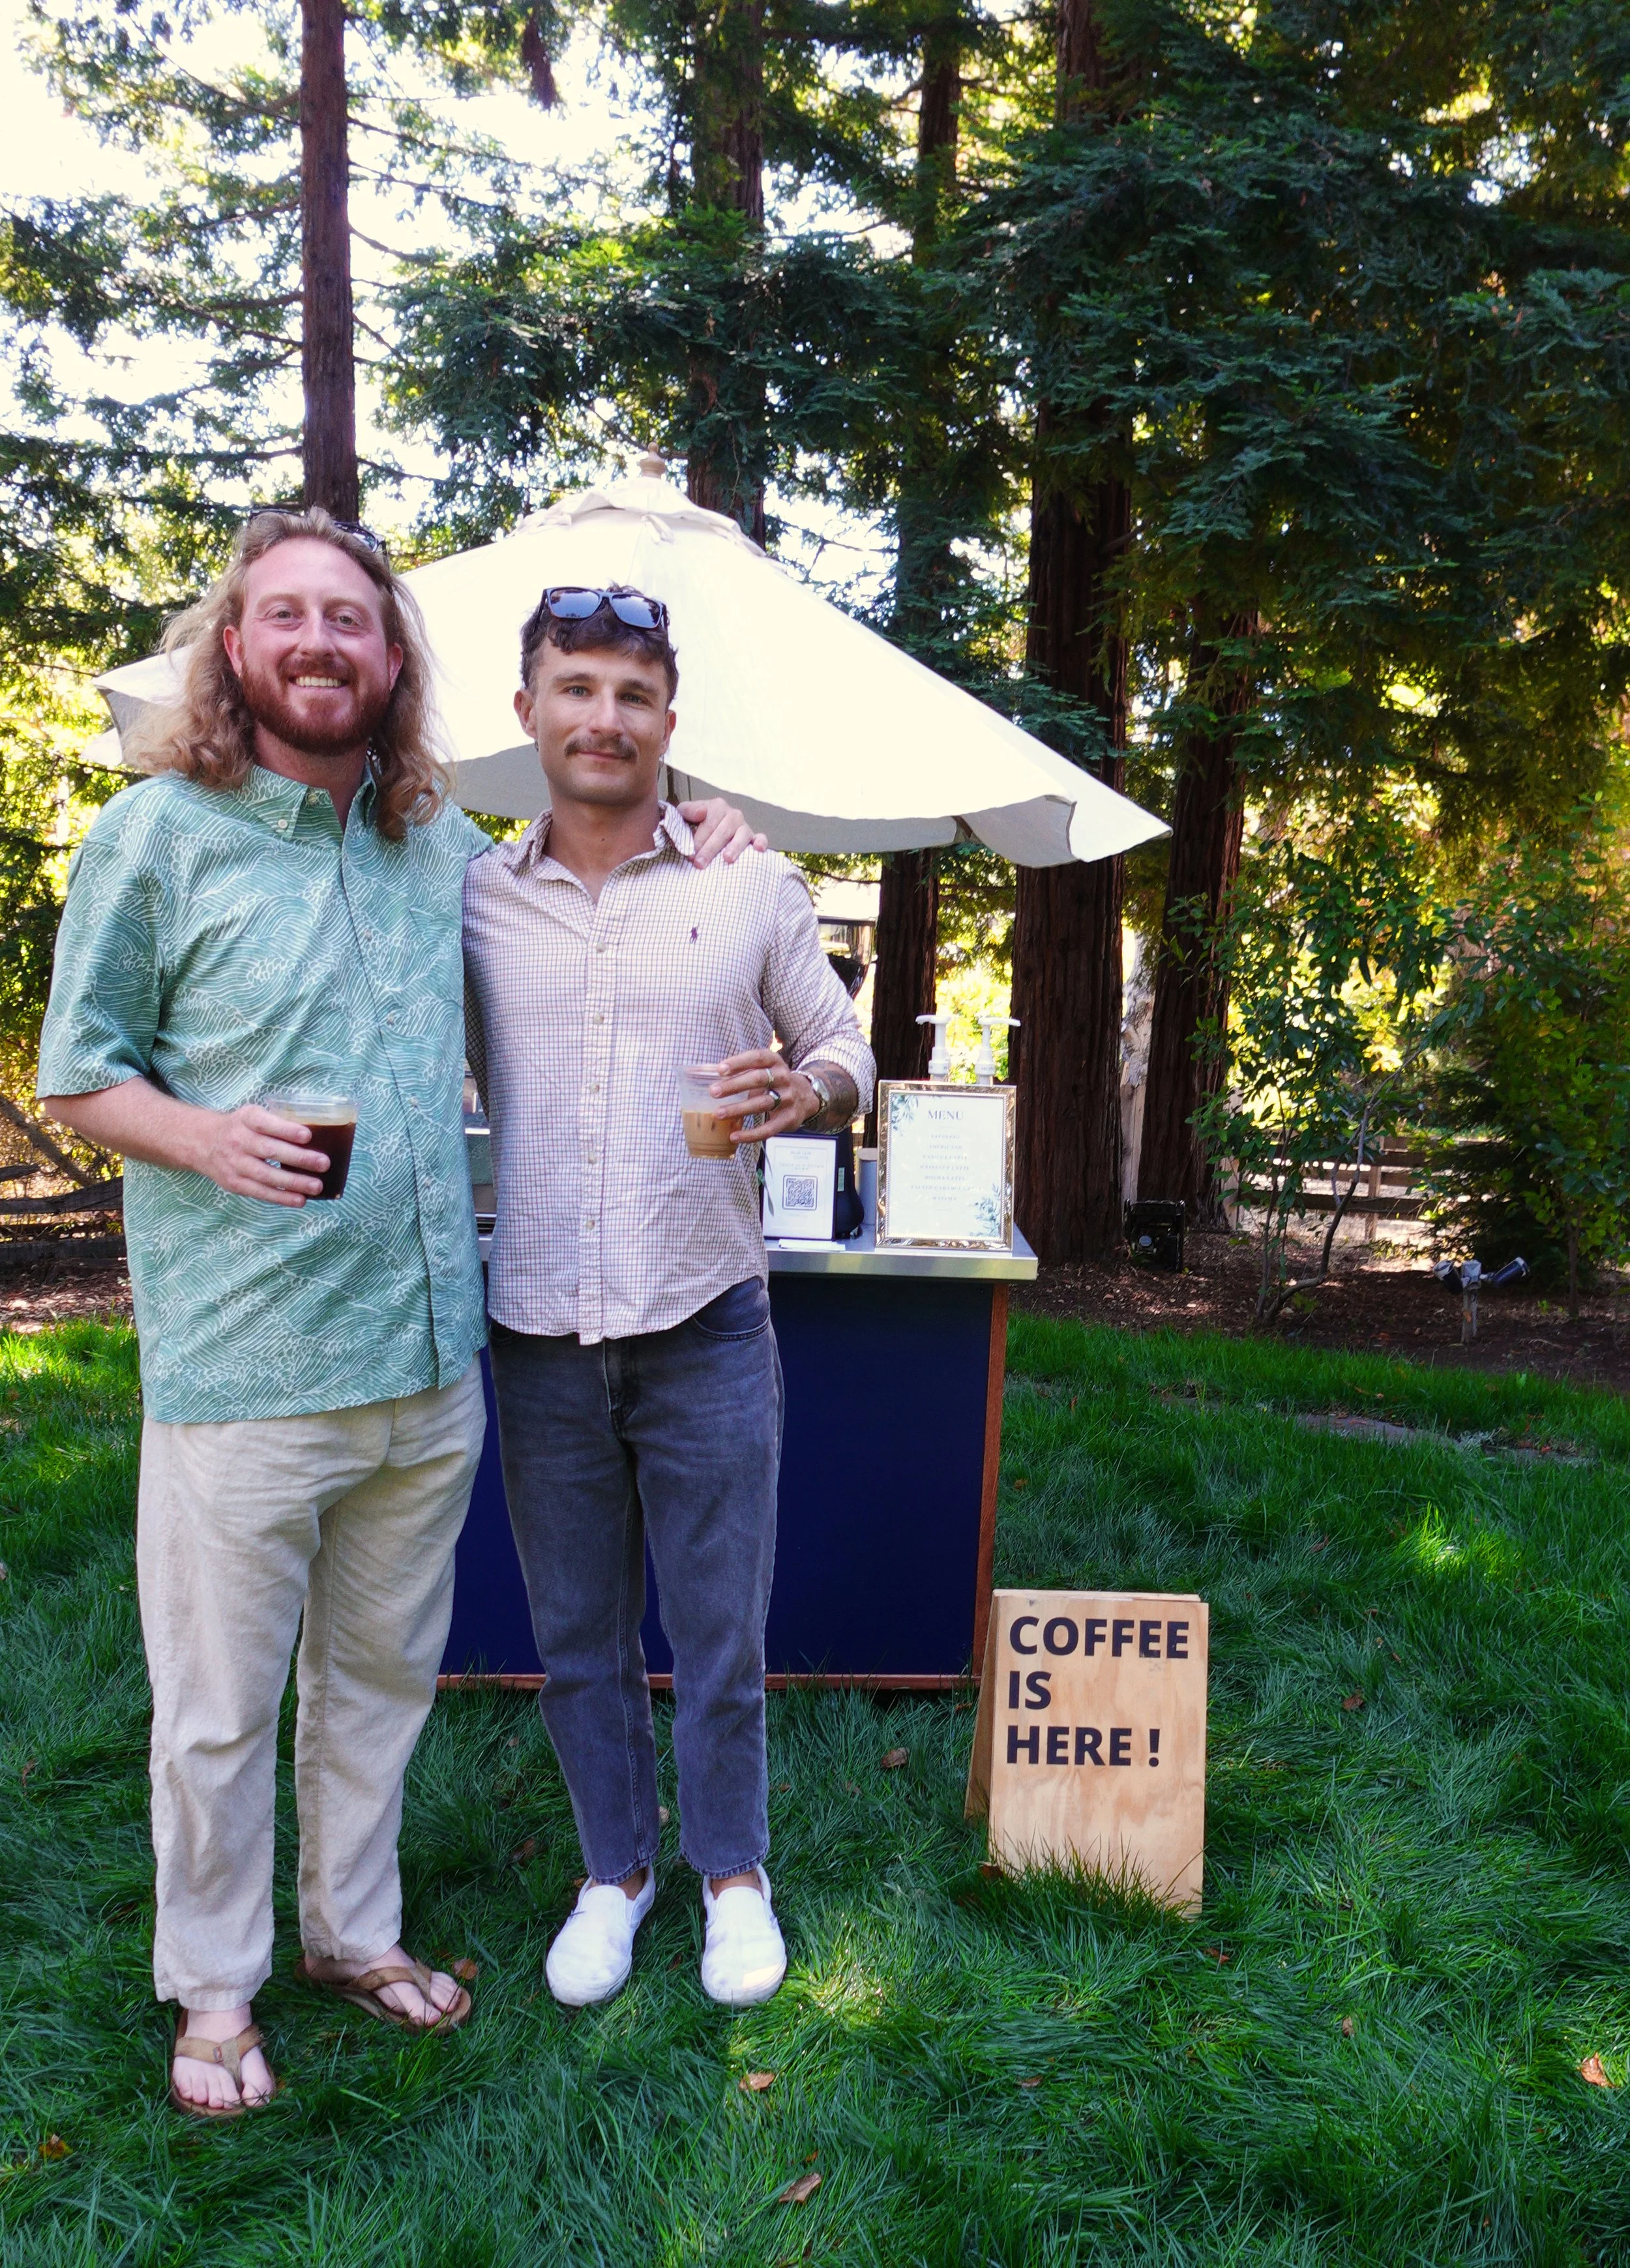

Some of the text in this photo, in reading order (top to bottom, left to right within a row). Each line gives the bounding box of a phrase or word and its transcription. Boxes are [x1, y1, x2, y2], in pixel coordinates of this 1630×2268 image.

[927, 1110, 964, 1120] MENU
[1009, 1616, 1189, 1659] COFFEE
[1008, 1671, 1052, 1710] IS
[1007, 1725, 1132, 1766] HERE
